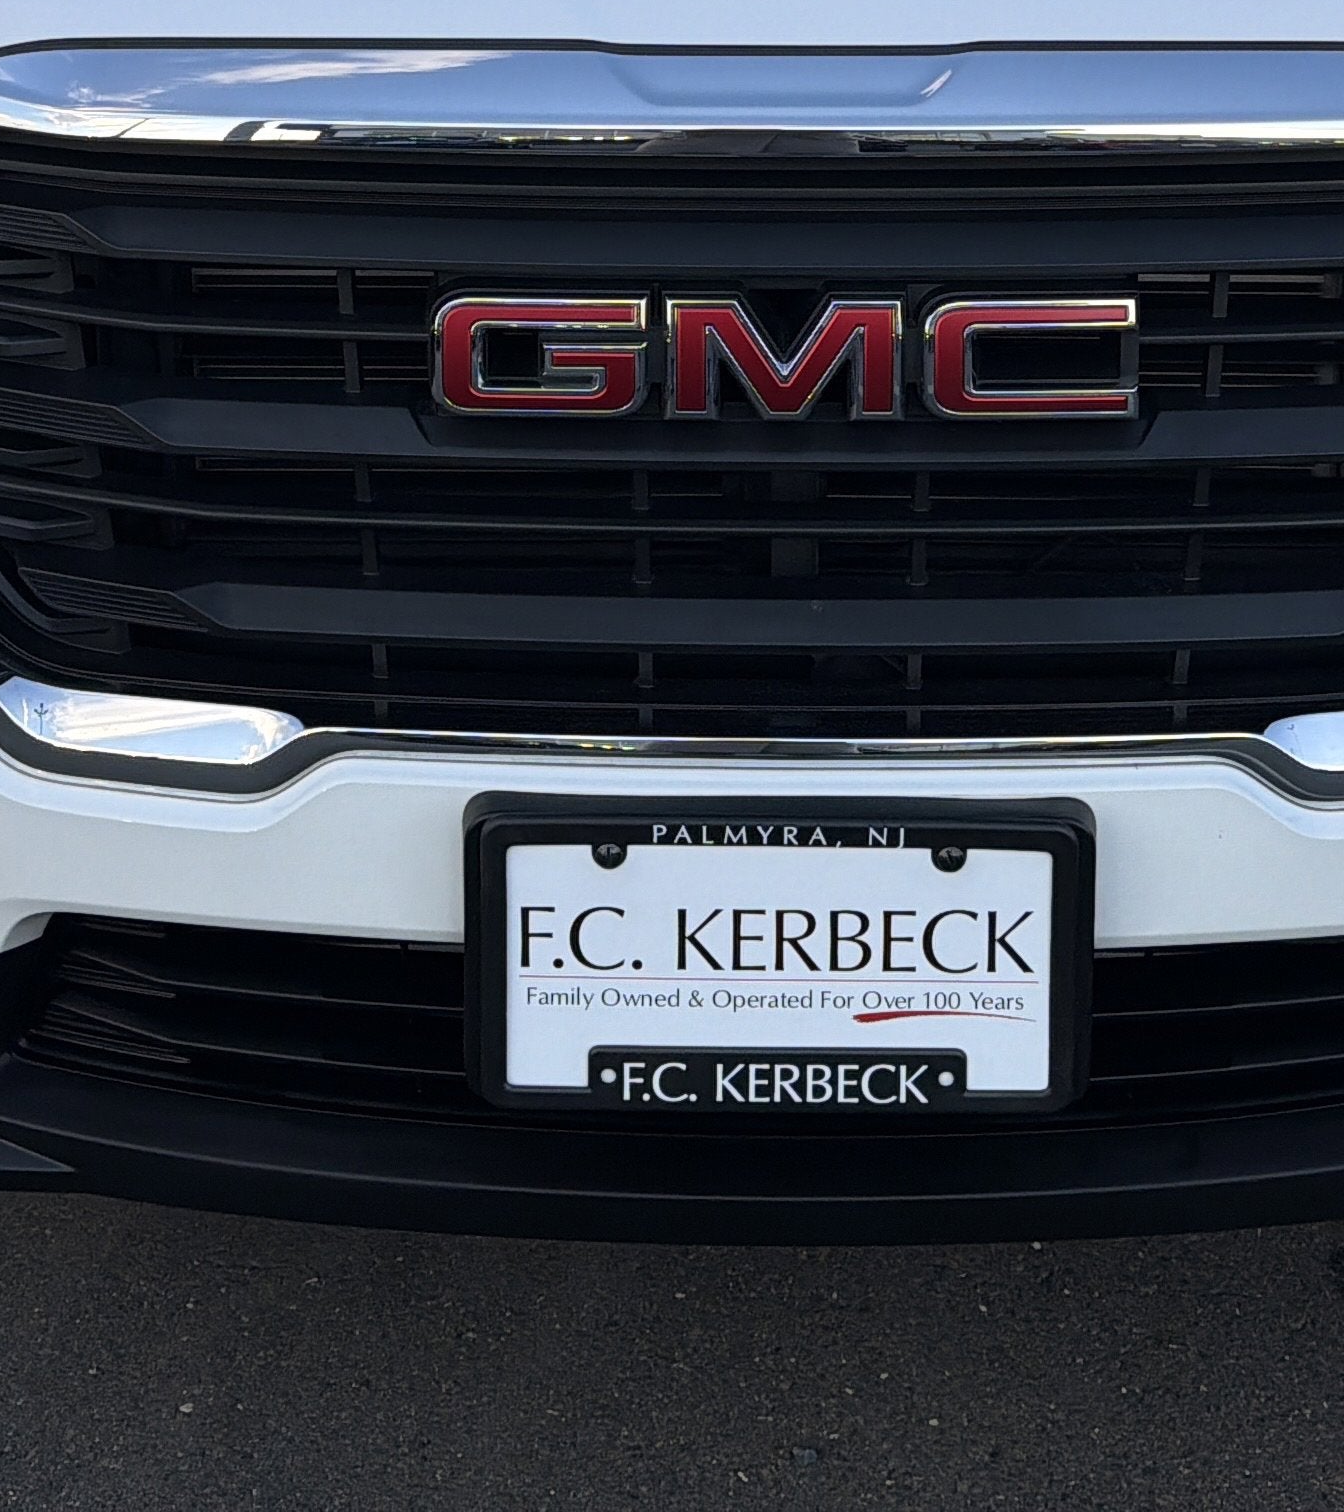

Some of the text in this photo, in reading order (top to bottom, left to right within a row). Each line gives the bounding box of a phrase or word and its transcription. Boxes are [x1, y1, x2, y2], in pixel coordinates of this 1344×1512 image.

[432, 292, 1140, 420] GMC
[652, 824, 907, 848] PALMYRA, NJ
[519, 906, 1035, 975] F.C. KERBECK
[526, 987, 1025, 1012] Family Owned & Operated For Over 100 Years
[622, 1062, 930, 1105] F.C. KERBECK
